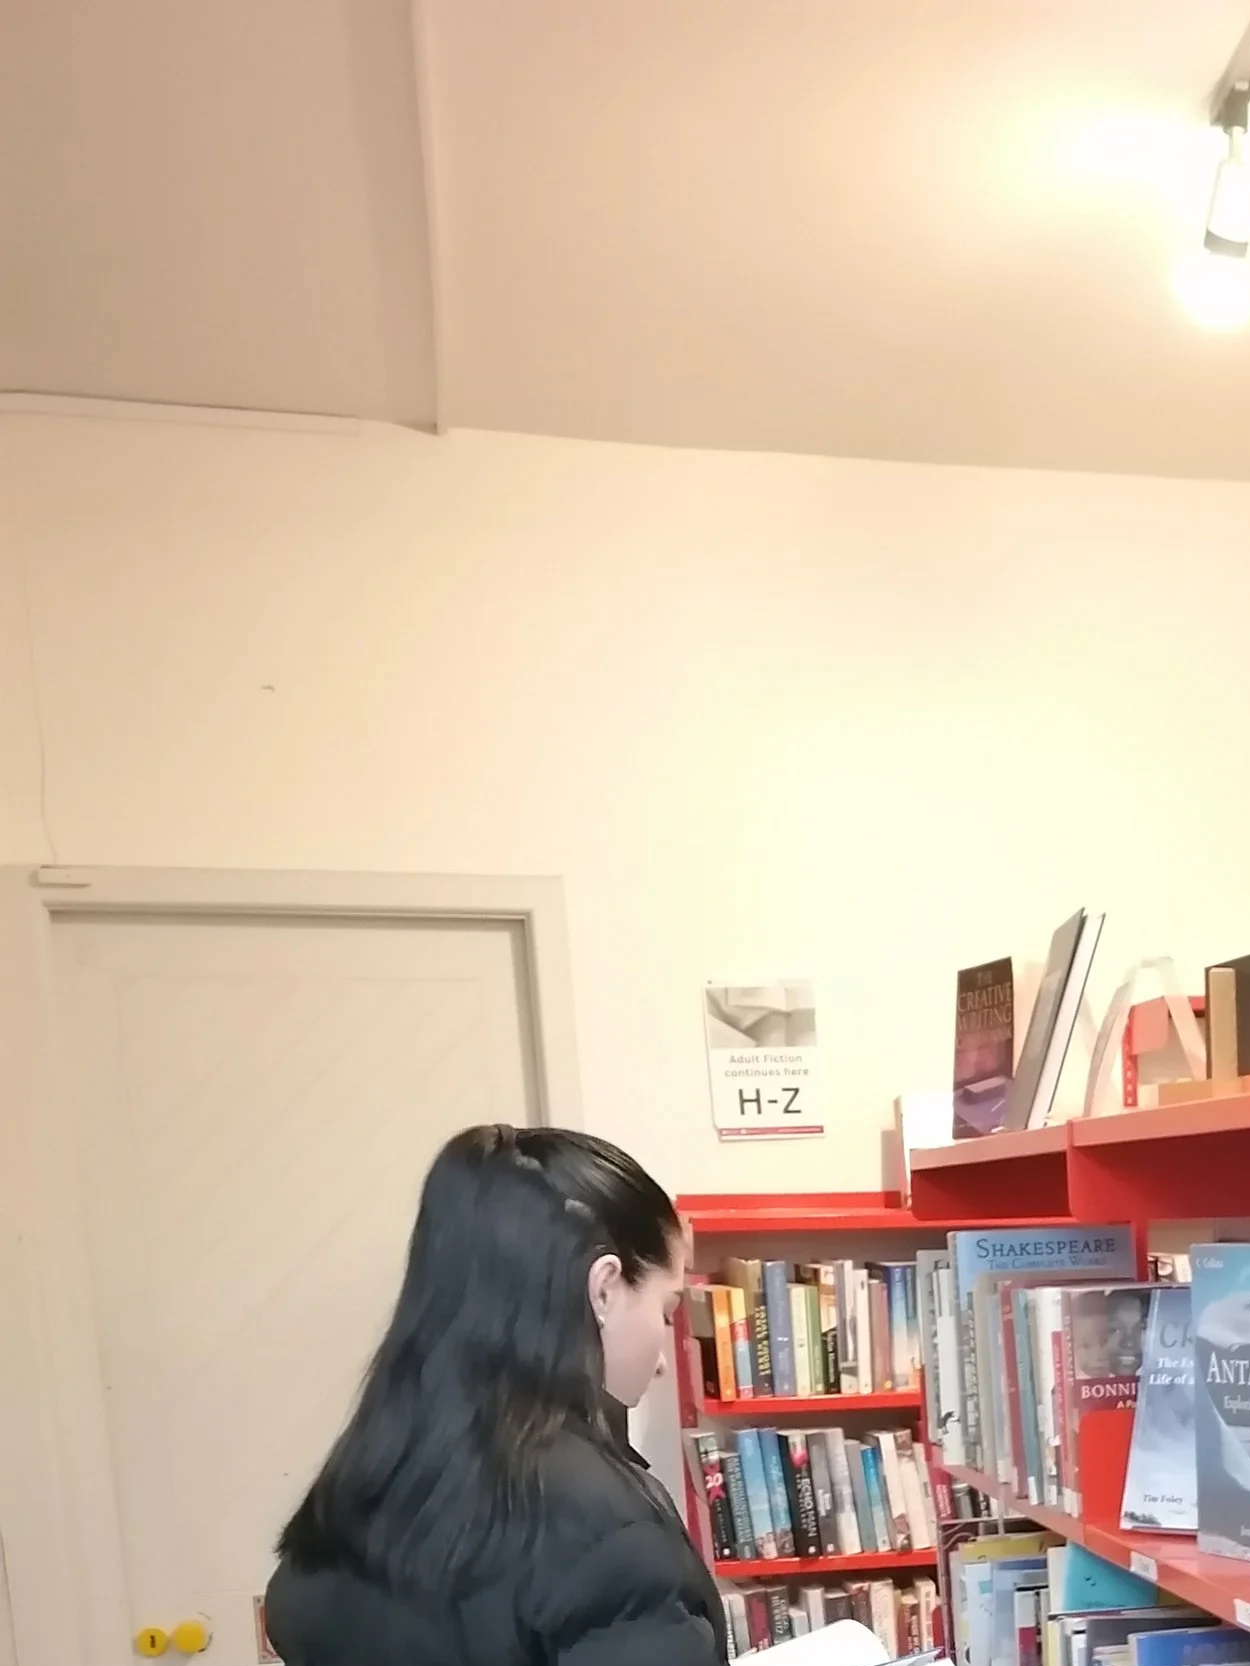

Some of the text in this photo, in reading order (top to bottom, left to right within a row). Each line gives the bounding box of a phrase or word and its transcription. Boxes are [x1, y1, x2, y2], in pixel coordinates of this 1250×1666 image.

[957, 982, 1012, 1012] CREATIVE
[957, 1004, 1012, 1031] WRITING
[730, 1053, 802, 1064] Adult Fiction
[725, 1066, 809, 1077] continues here
[739, 1087, 801, 1115] H-Z
[976, 1238, 1116, 1259] SHAKESPEARE
[1157, 1358, 1176, 1369] The
[1149, 1373, 1172, 1386] Life
[803, 1477, 817, 1537] ECHO MAN
